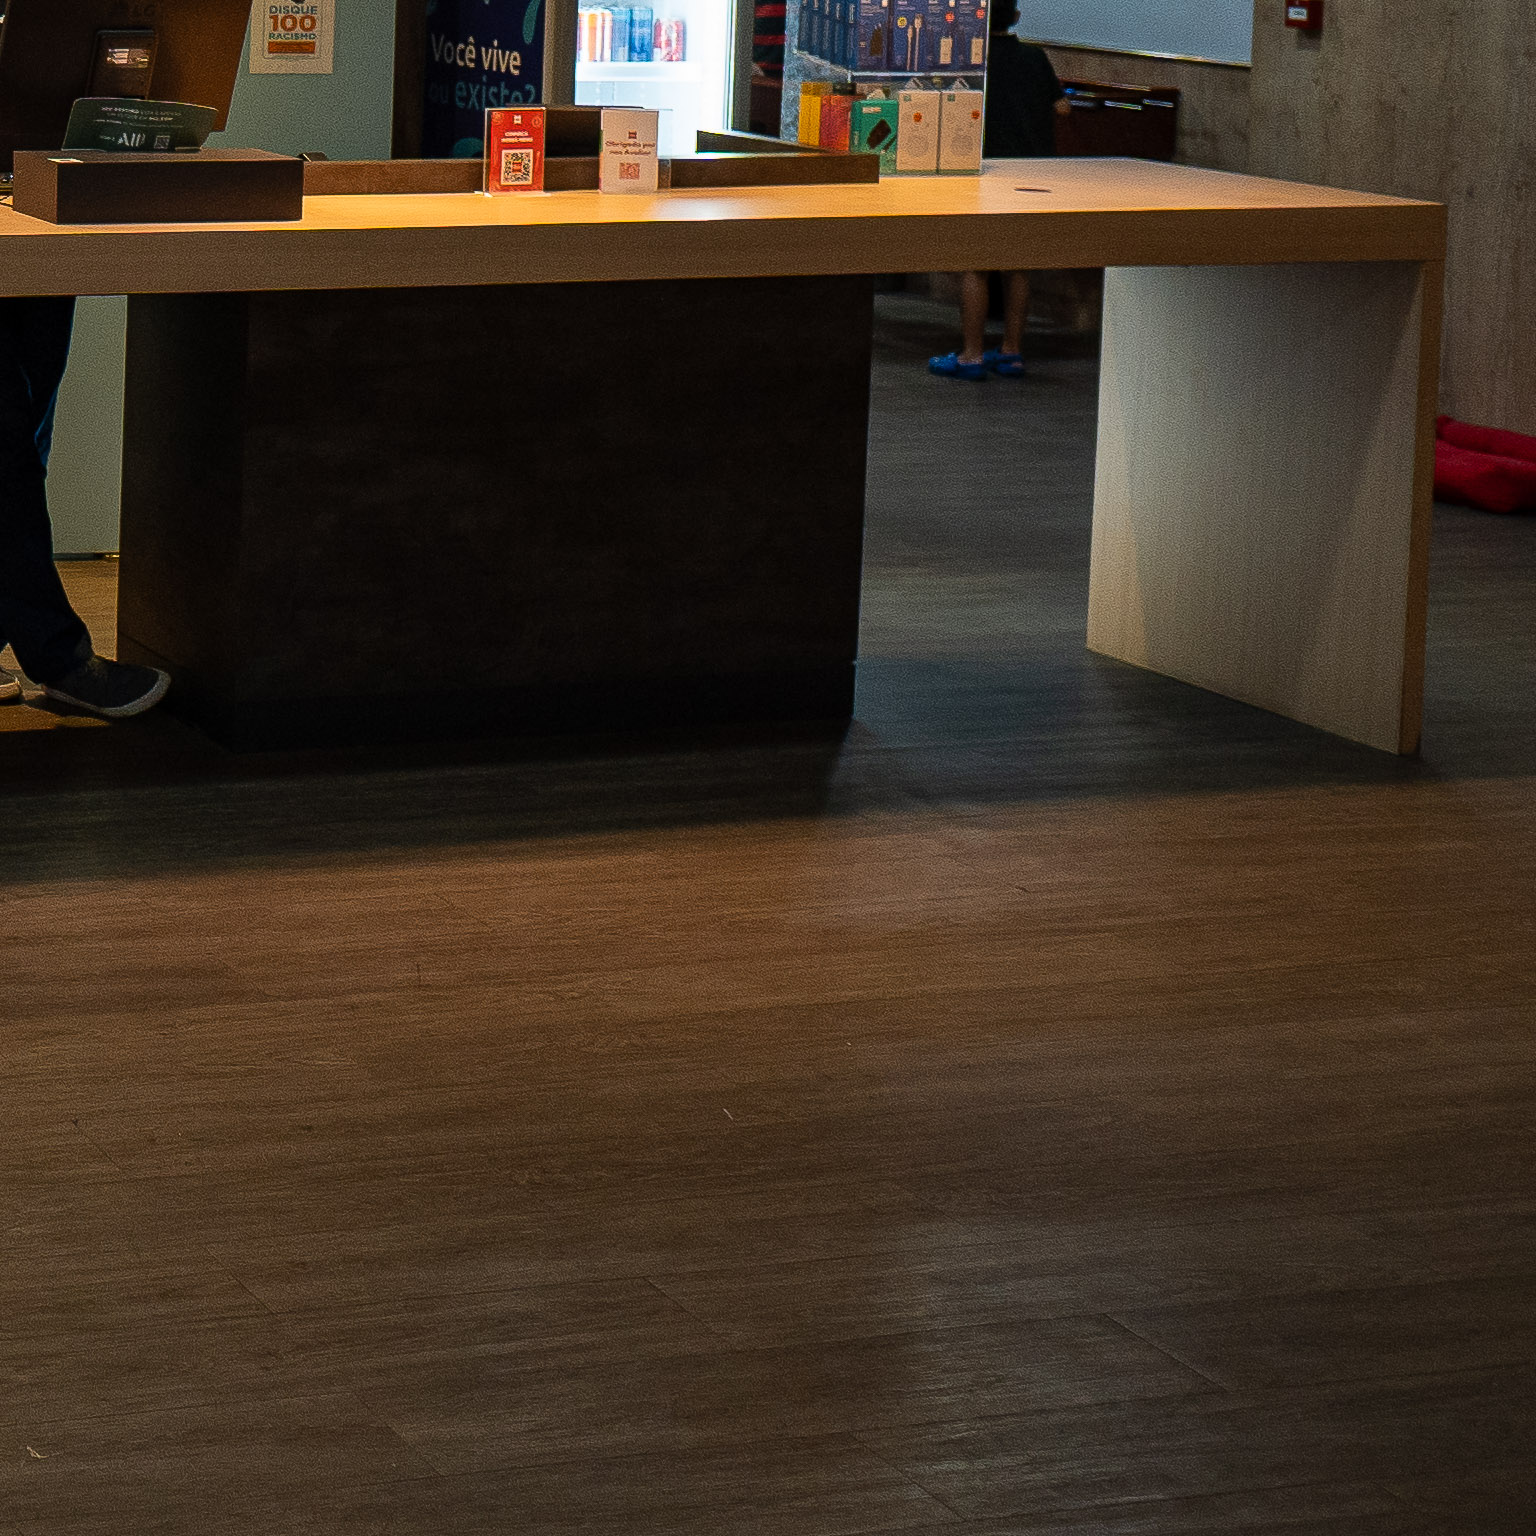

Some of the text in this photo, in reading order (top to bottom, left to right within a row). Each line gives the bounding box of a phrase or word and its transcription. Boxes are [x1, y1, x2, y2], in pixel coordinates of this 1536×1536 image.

[269, 5, 318, 15] DISQUE
[269, 15, 317, 32] 100
[268, 32, 317, 41] RACISMO
[431, 34, 522, 76] Você vive
